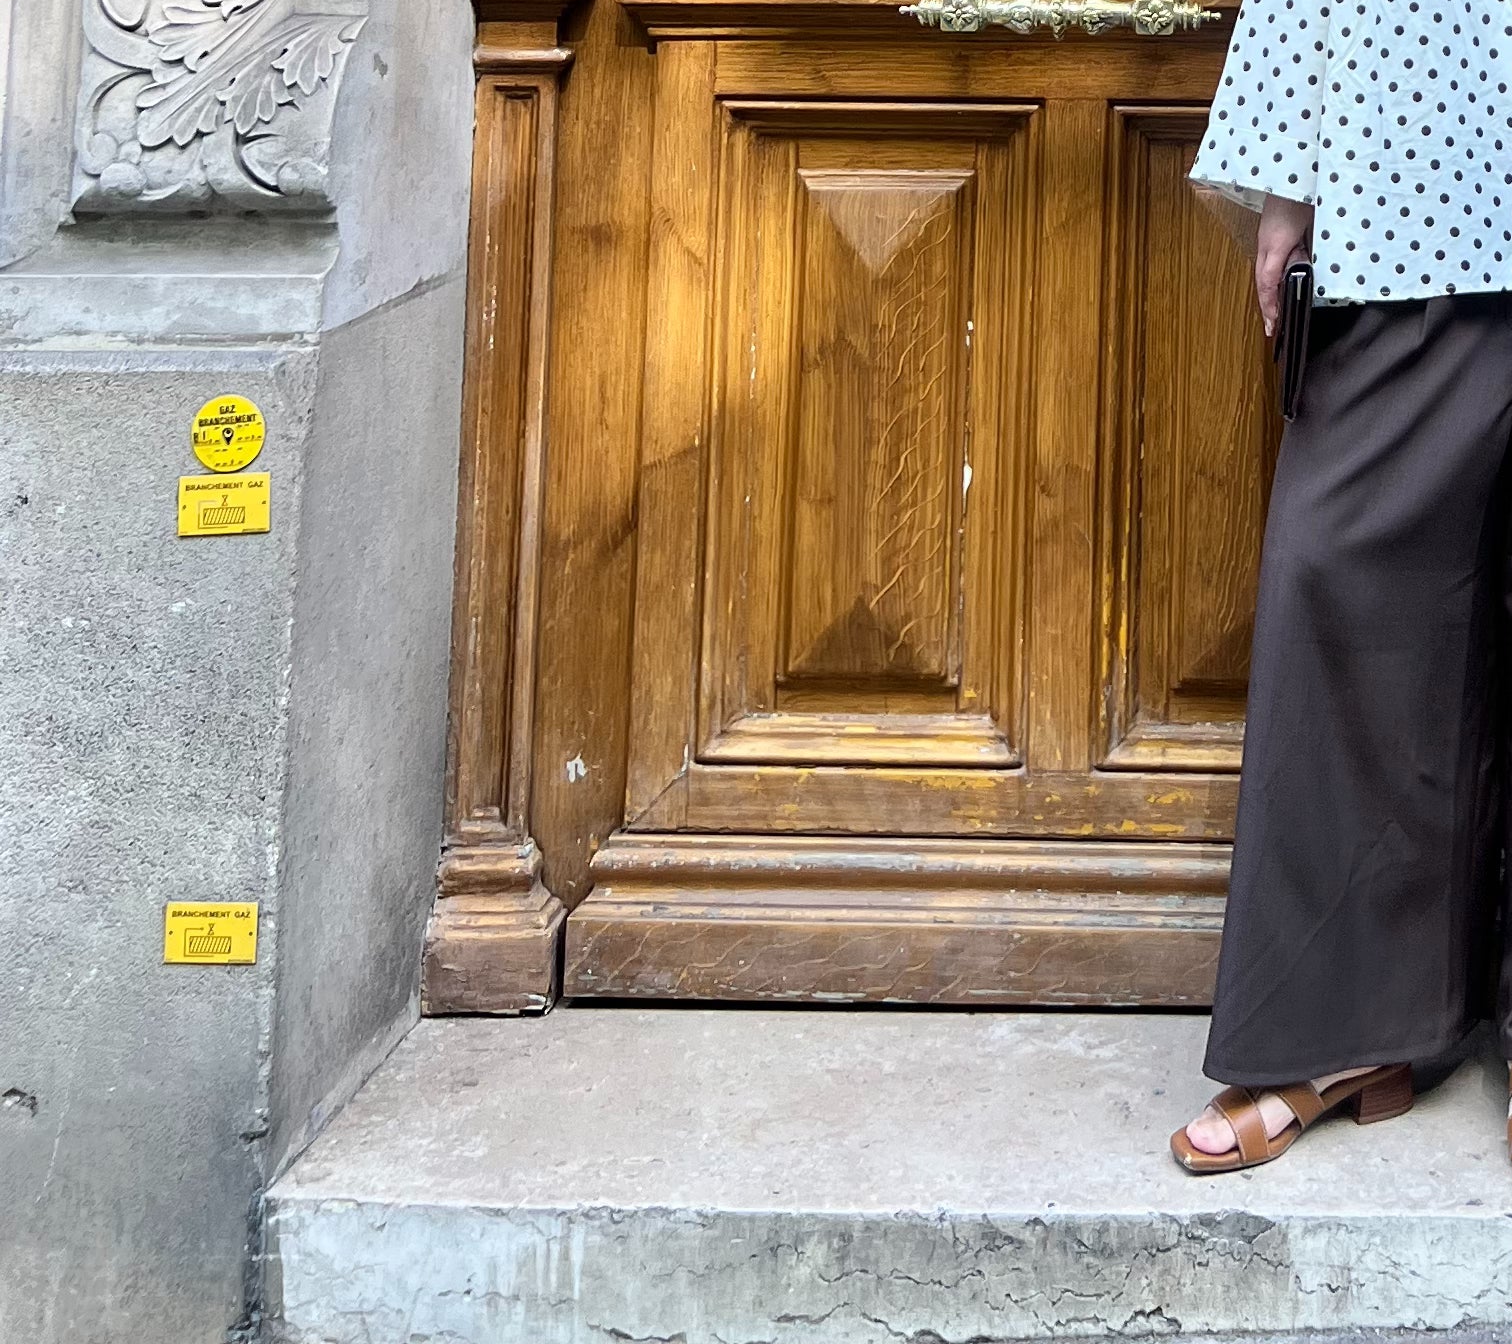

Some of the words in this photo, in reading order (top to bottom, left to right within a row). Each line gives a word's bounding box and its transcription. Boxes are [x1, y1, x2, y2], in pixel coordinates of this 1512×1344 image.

[219, 405, 236, 414] GAZ
[198, 414, 257, 427] BRANCHEMENT
[185, 481, 244, 491] BRANCHEMENT
[247, 480, 264, 489] GAZ
[171, 910, 231, 918] BRANCHEMENT
[234, 911, 251, 919] GAZ
